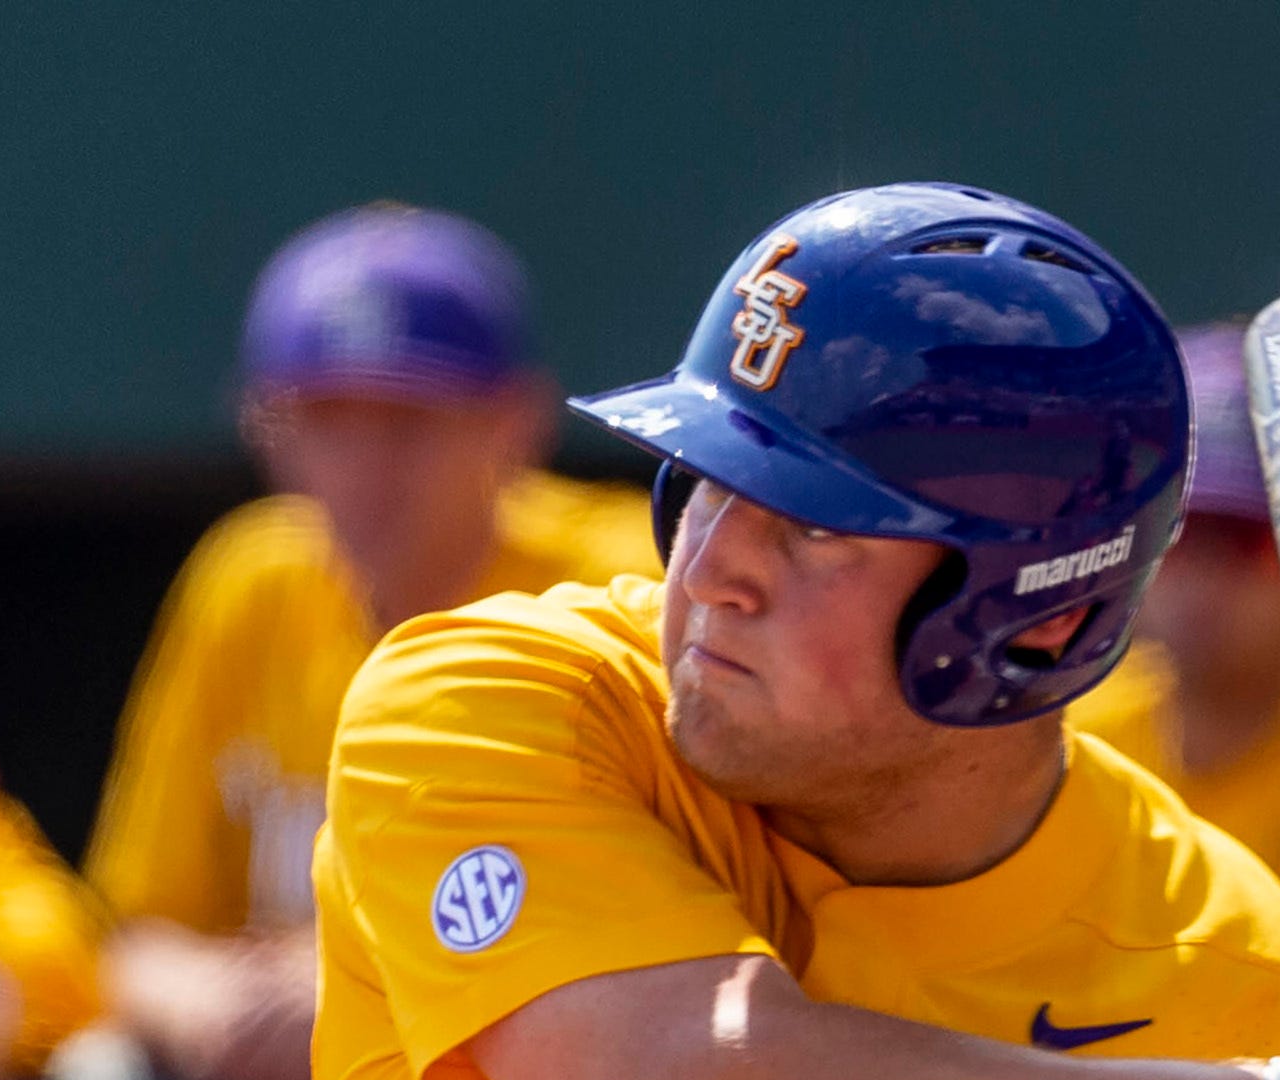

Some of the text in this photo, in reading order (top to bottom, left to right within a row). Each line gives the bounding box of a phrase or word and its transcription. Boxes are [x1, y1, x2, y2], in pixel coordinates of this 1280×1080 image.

[731, 233, 808, 390] LSU
[1014, 524, 1136, 595] marucci
[437, 852, 518, 944] SEC
